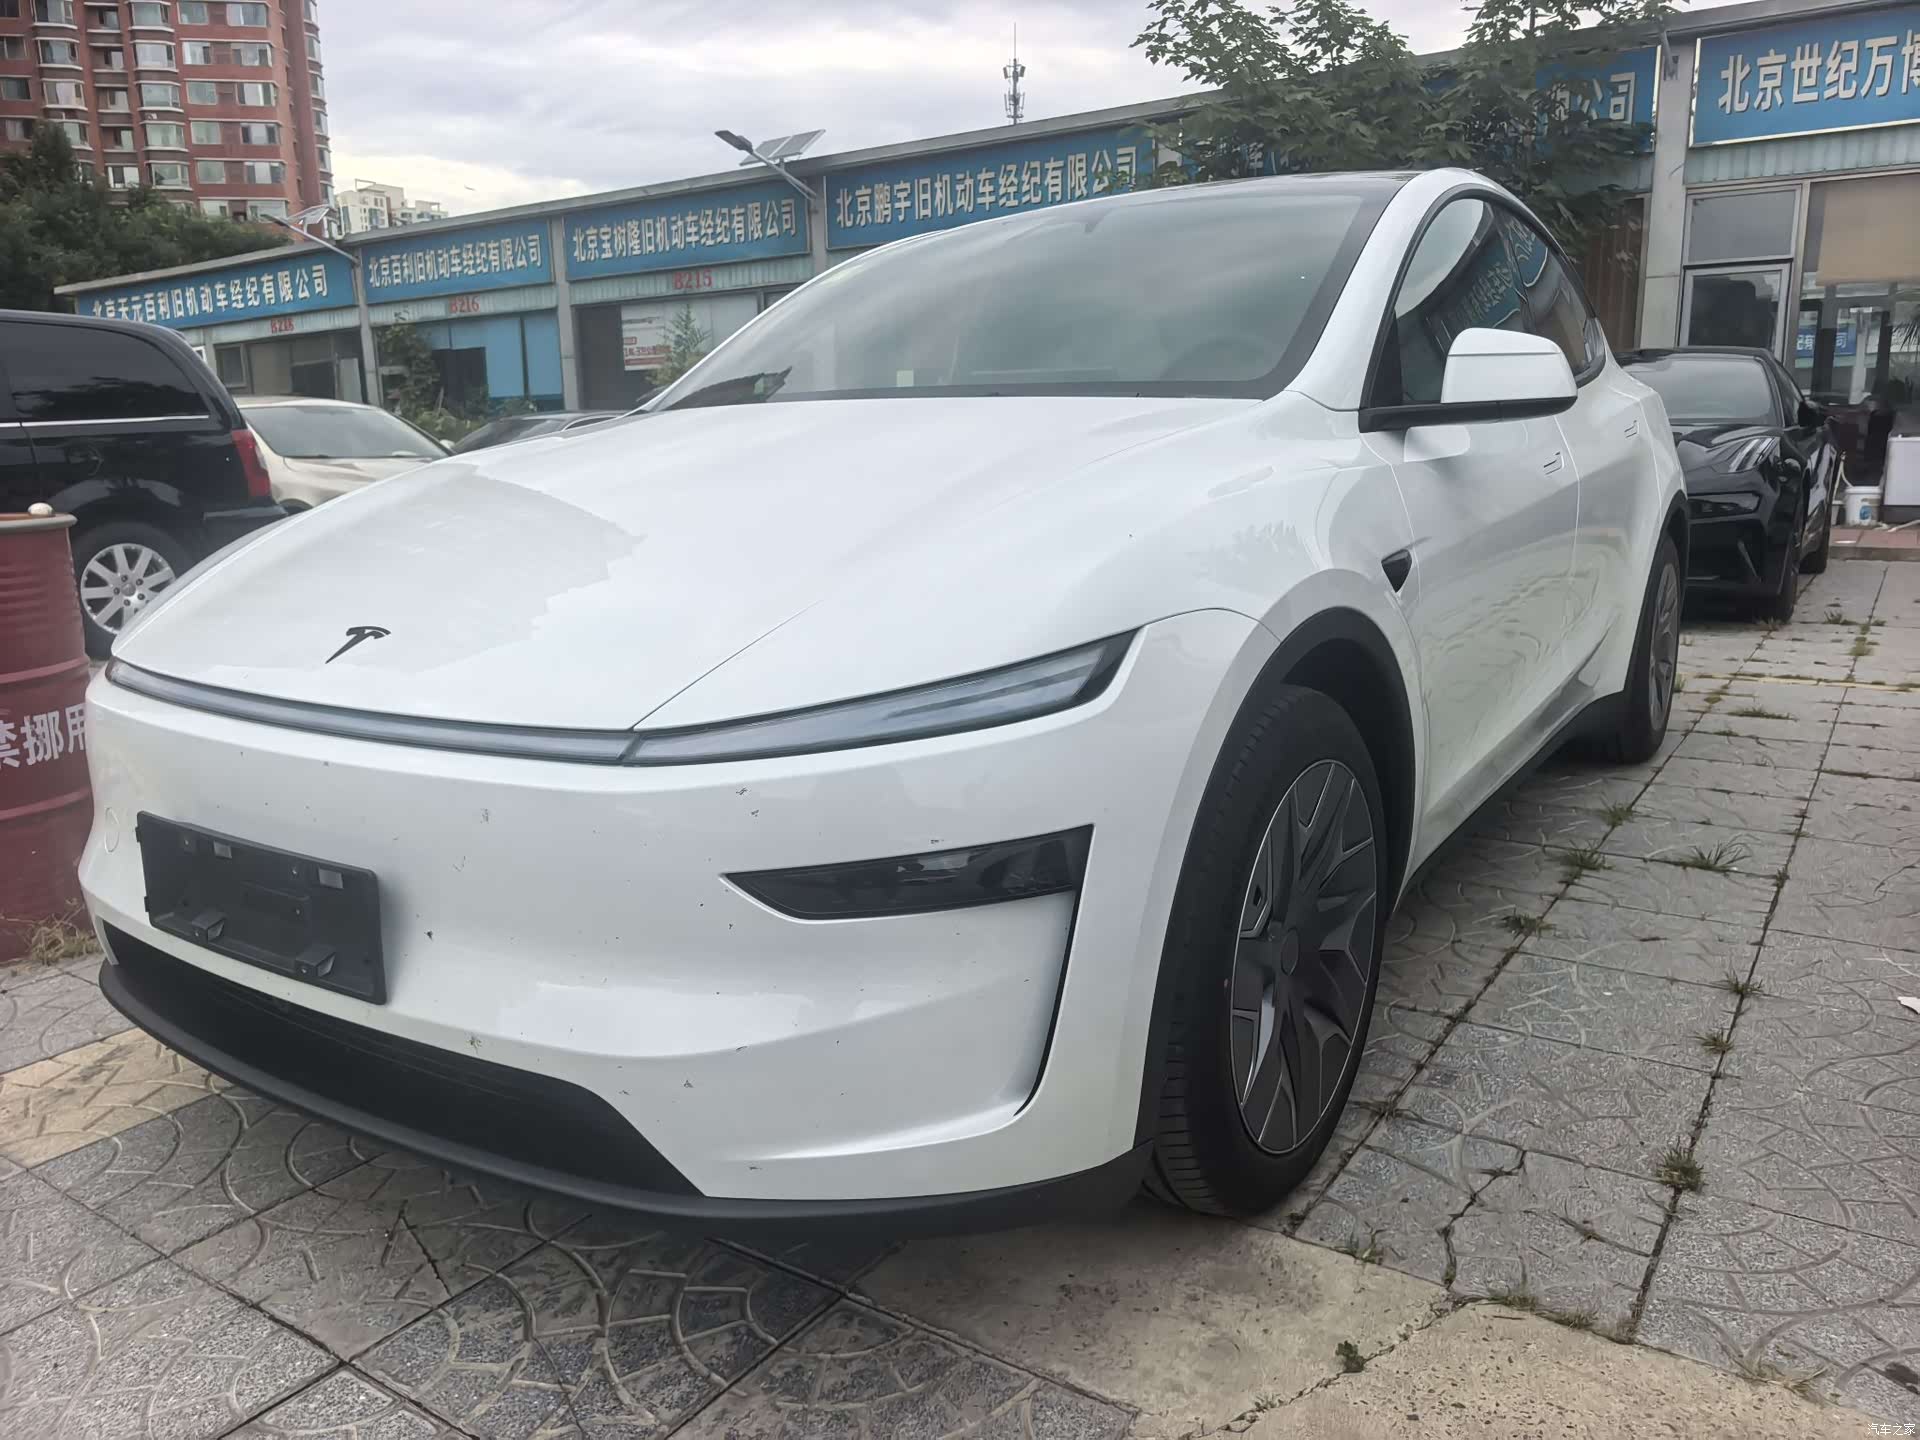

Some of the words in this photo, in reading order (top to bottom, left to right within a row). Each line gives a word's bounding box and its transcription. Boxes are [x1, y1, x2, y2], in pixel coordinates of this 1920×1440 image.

[836, 146, 1137, 228] 北京鹏宇旧机动车经纪有限公司
[573, 199, 797, 262] 北京宝树隆旧机动车经纪有限公司
[369, 234, 542, 288] 北京百利旧机动车经纪有限公司
[450, 296, 480, 313] B216
